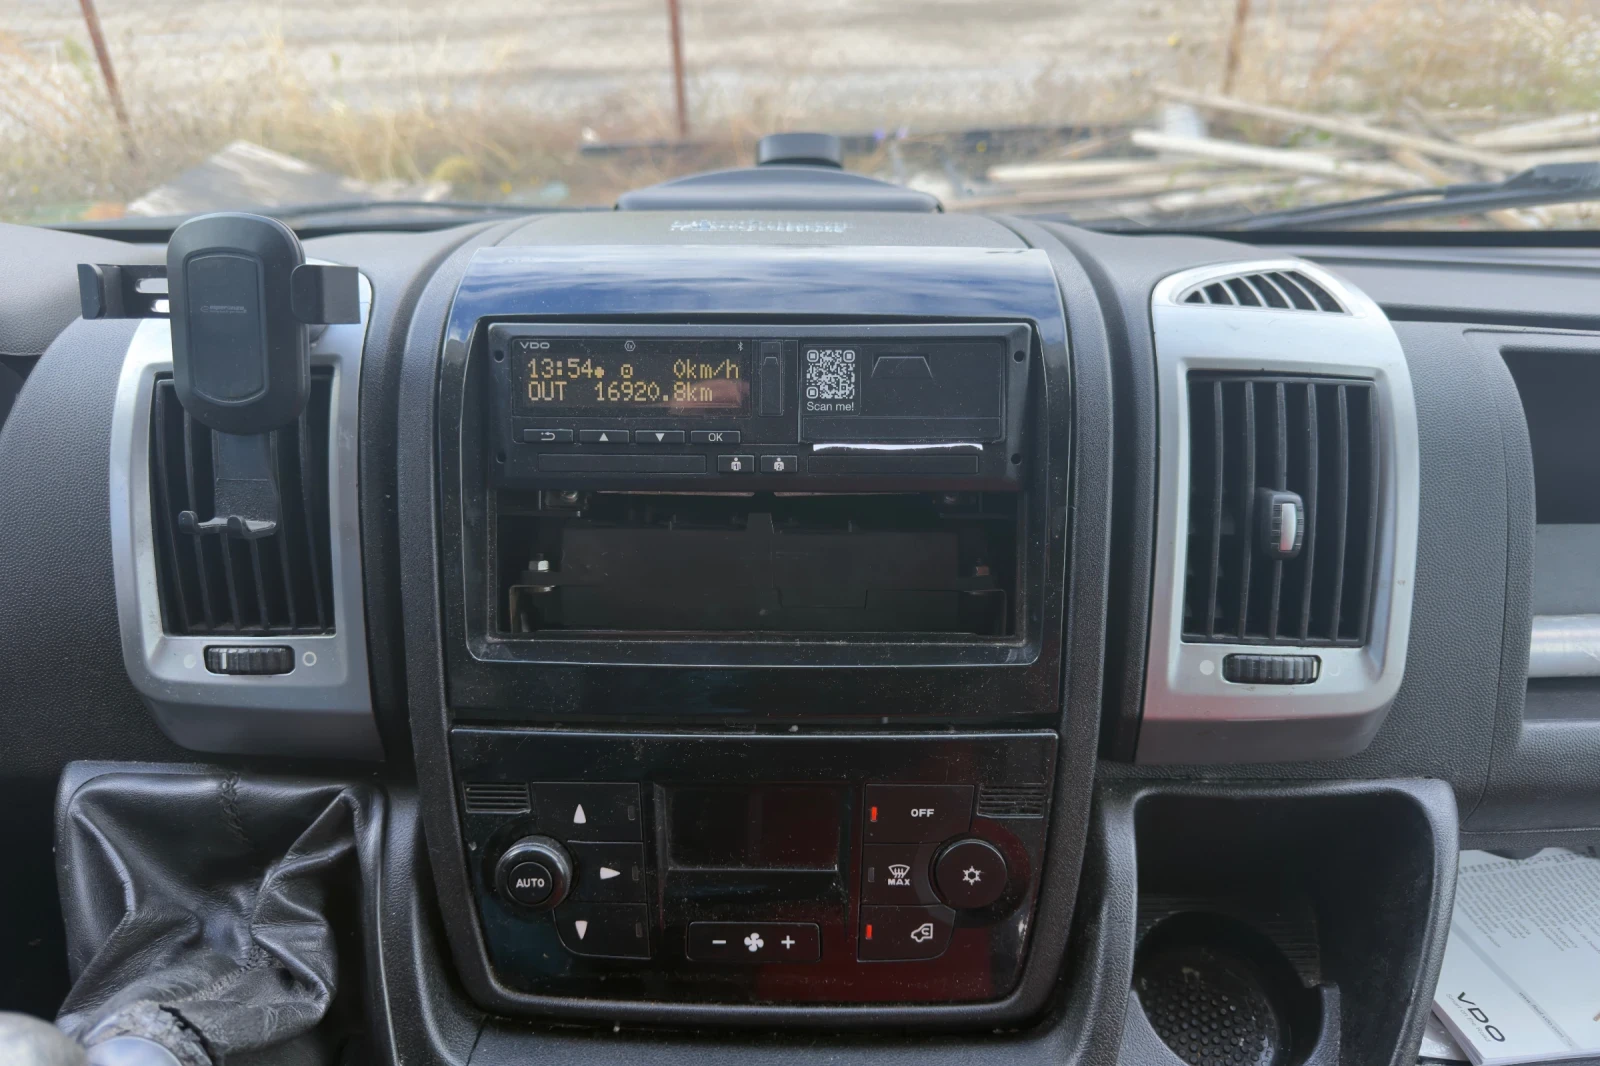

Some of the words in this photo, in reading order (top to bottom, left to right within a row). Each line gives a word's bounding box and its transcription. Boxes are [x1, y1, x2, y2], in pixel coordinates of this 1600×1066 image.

[519, 341, 550, 350] VDO
[527, 358, 593, 379] 13:54
[673, 358, 739, 379] 0km/h
[527, 381, 567, 401] OUT
[594, 381, 713, 402] 16920.8km
[806, 401, 833, 412] Scan
[835, 401, 854, 412] me!
[708, 432, 723, 443] OK
[910, 808, 934, 818] OFF
[515, 878, 545, 888] AUTO
[1457, 991, 1505, 1042] VDO
